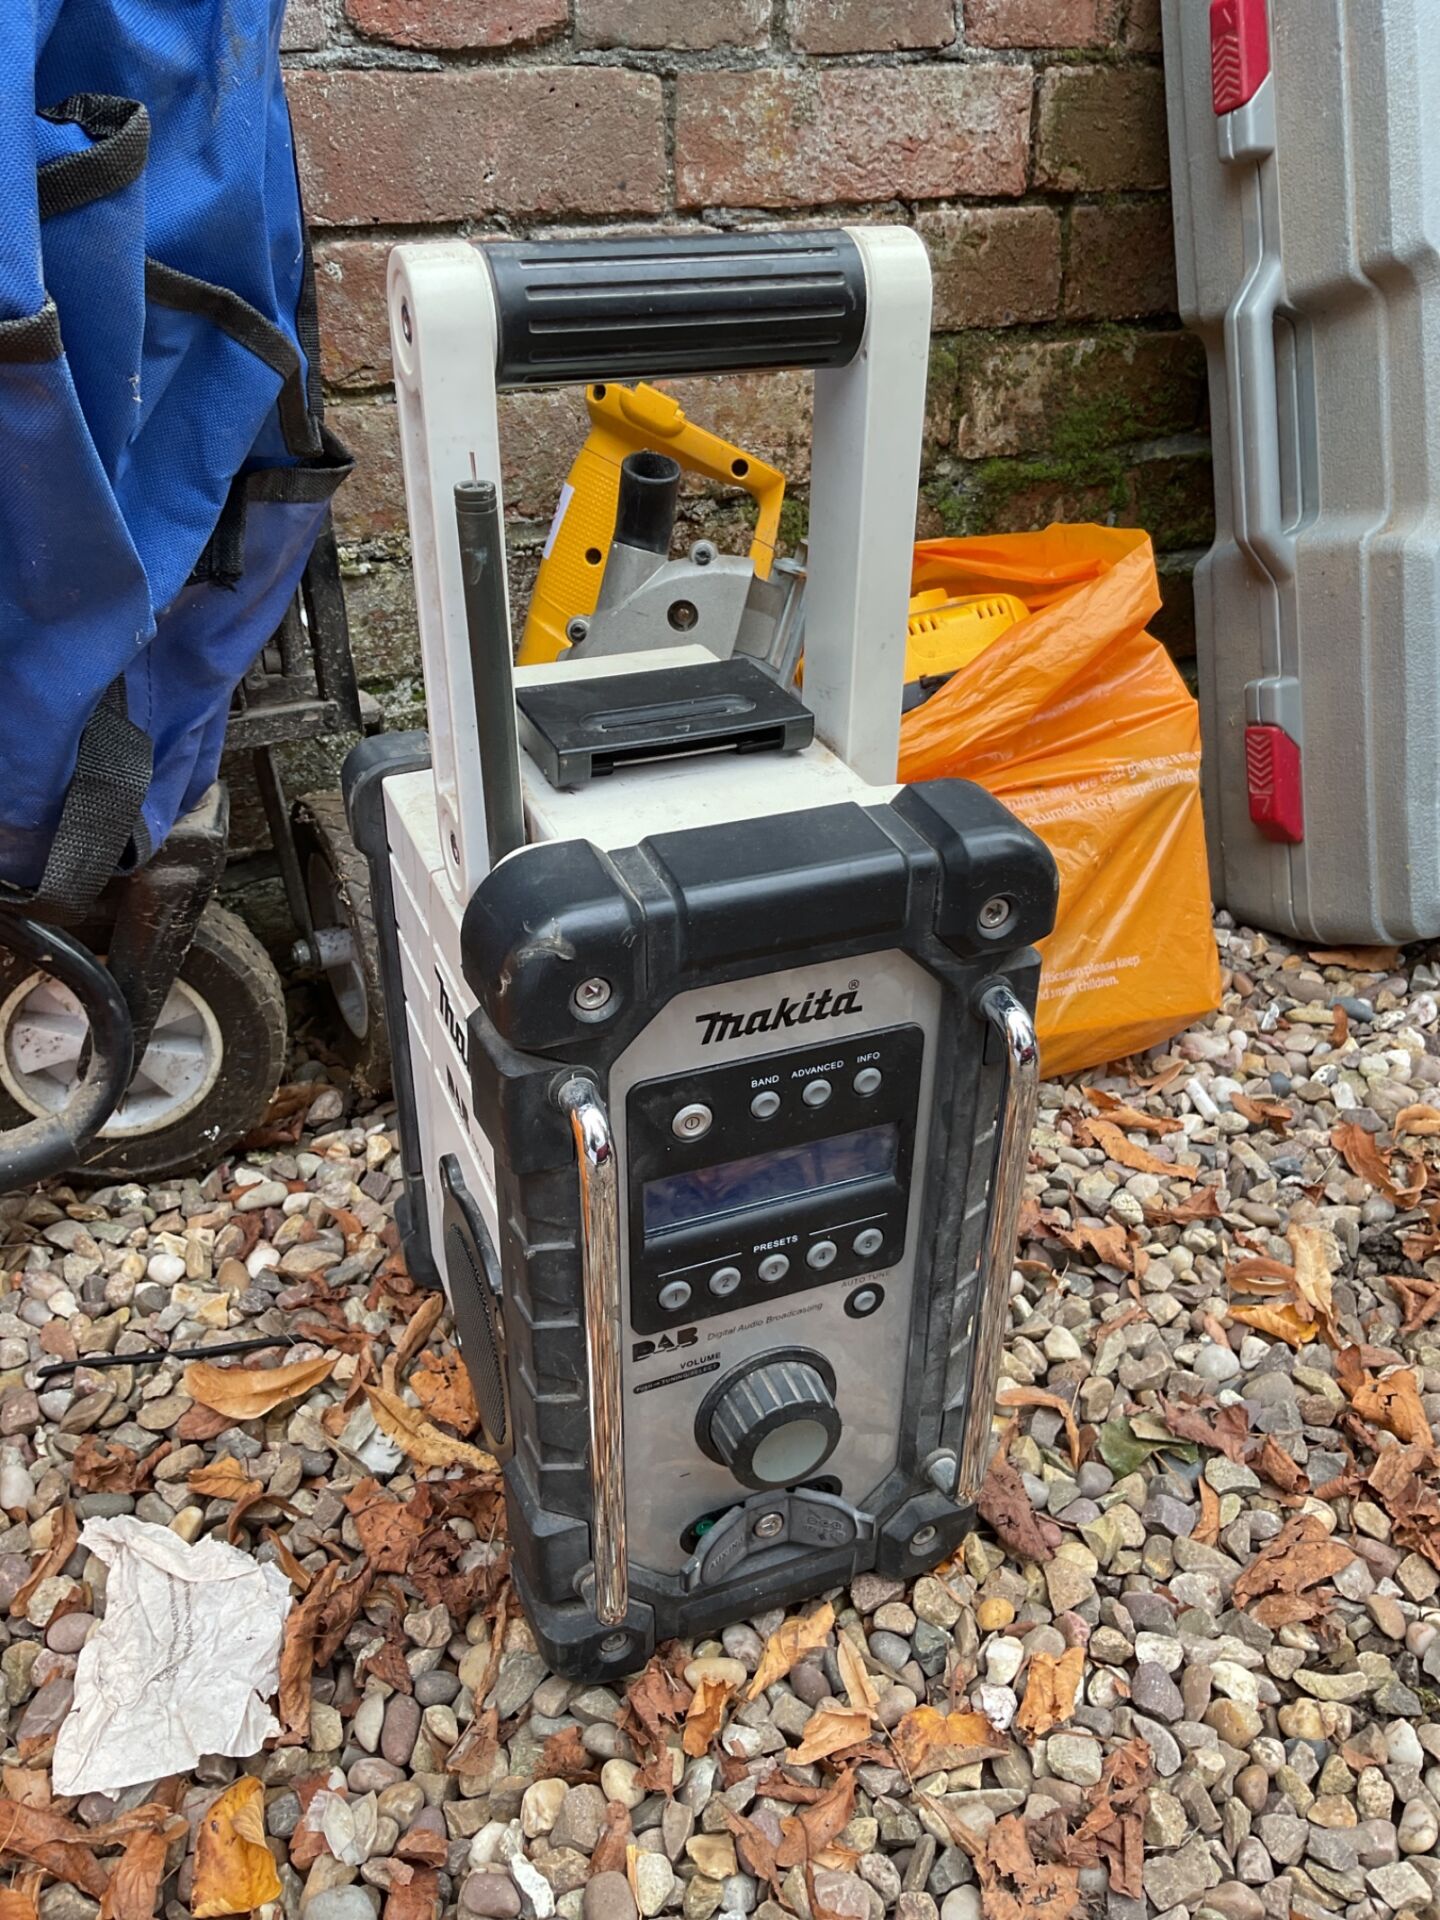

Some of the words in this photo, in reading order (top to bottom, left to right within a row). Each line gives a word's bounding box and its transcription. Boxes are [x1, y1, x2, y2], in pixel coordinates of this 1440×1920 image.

[750, 1074, 780, 1089] BAND
[790, 1060, 845, 1079] ADVANCED
[856, 1051, 881, 1064] INFO
[752, 1234, 799, 1254] PRESETS
[840, 1275, 866, 1289] AUTO
[867, 1269, 891, 1281] TUNE
[632, 1327, 699, 1364] DAB
[707, 1326, 737, 1342] Digital
[737, 1319, 764, 1333] Audio
[765, 1302, 824, 1326] Broadcasting
[679, 1350, 722, 1370] VOLUME
